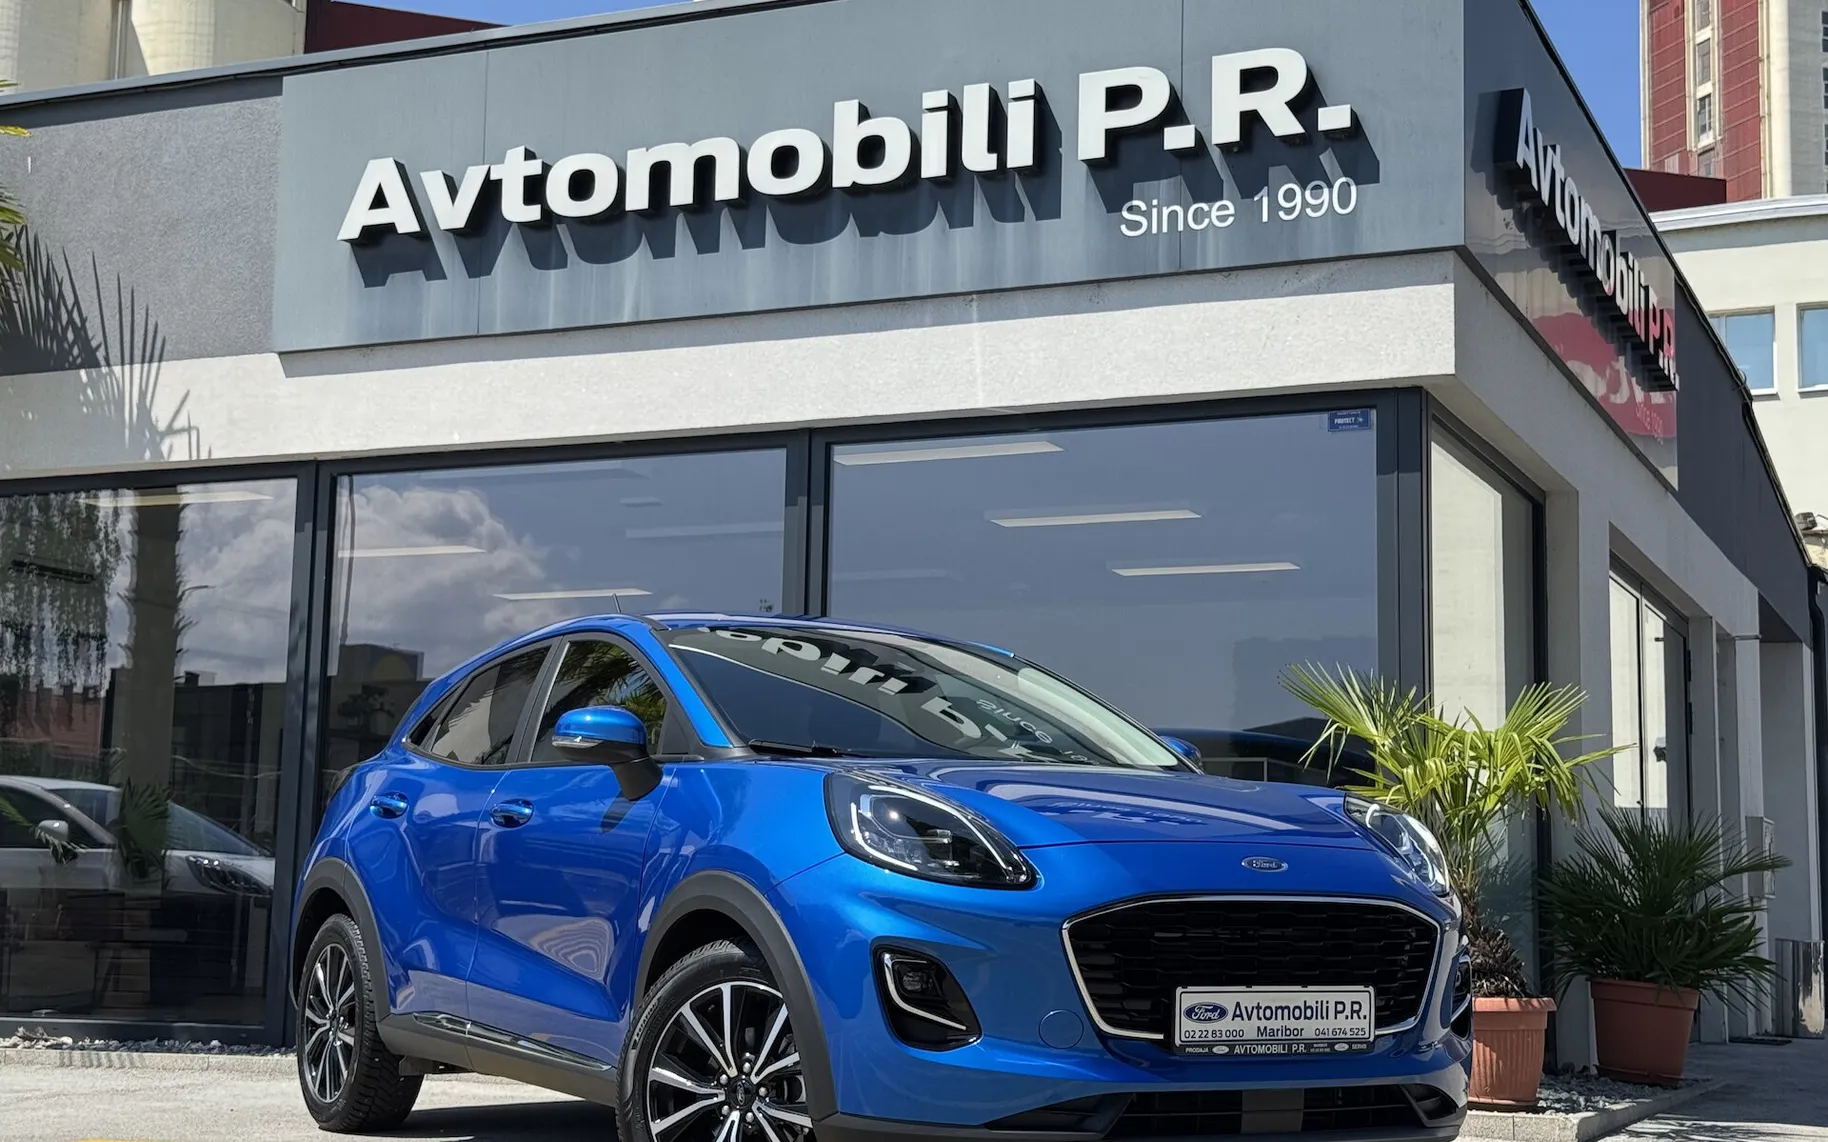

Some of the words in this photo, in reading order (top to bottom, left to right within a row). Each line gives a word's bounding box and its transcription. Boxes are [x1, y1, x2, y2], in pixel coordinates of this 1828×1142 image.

[336, 79, 1035, 241] Avtomobili
[1077, 47, 1352, 162] P.R.
[1120, 199, 1235, 237] Since
[1253, 177, 1357, 223] 1990
[1516, 88, 1646, 342] Avtomobili
[1191, 1004, 1221, 1020] Ford
[1231, 1000, 1330, 1022] Avtomobili
[1334, 1000, 1368, 1021] P.R.
[1184, 1029, 1197, 1039] 02
[1198, 1029, 1210, 1039] 22
[1211, 1029, 1223, 1039] 83
[1224, 1028, 1245, 1038] 000
[1256, 1025, 1305, 1038] Maribor
[1314, 1027, 1330, 1037] 041
[1331, 1027, 1348, 1037] 674
[1349, 1027, 1366, 1036] 525
[1234, 1044, 1288, 1055] AVTOMOBILI
[1292, 1043, 1307, 1053] P.R.
